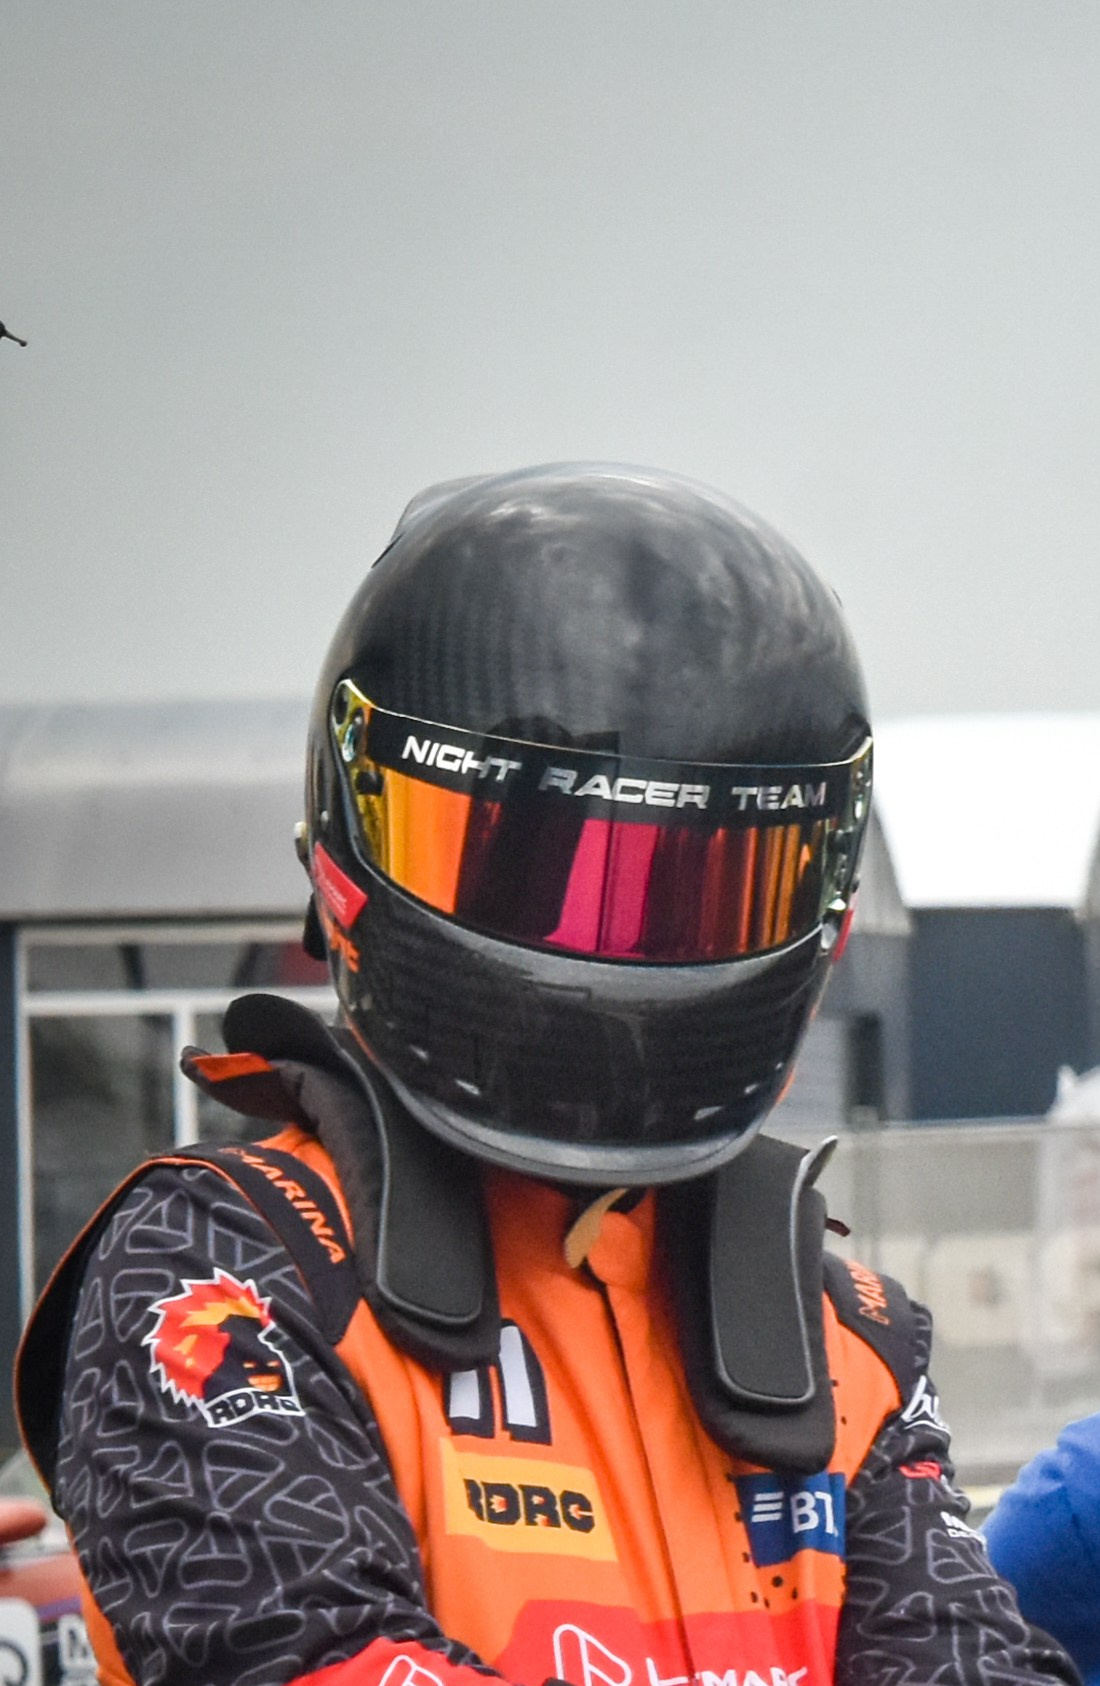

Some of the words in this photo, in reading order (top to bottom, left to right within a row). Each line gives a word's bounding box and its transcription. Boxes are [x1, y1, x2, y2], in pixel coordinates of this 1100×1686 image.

[401, 735, 522, 781] NIGHT
[538, 766, 711, 810] RACER
[731, 781, 827, 812] TEAM
